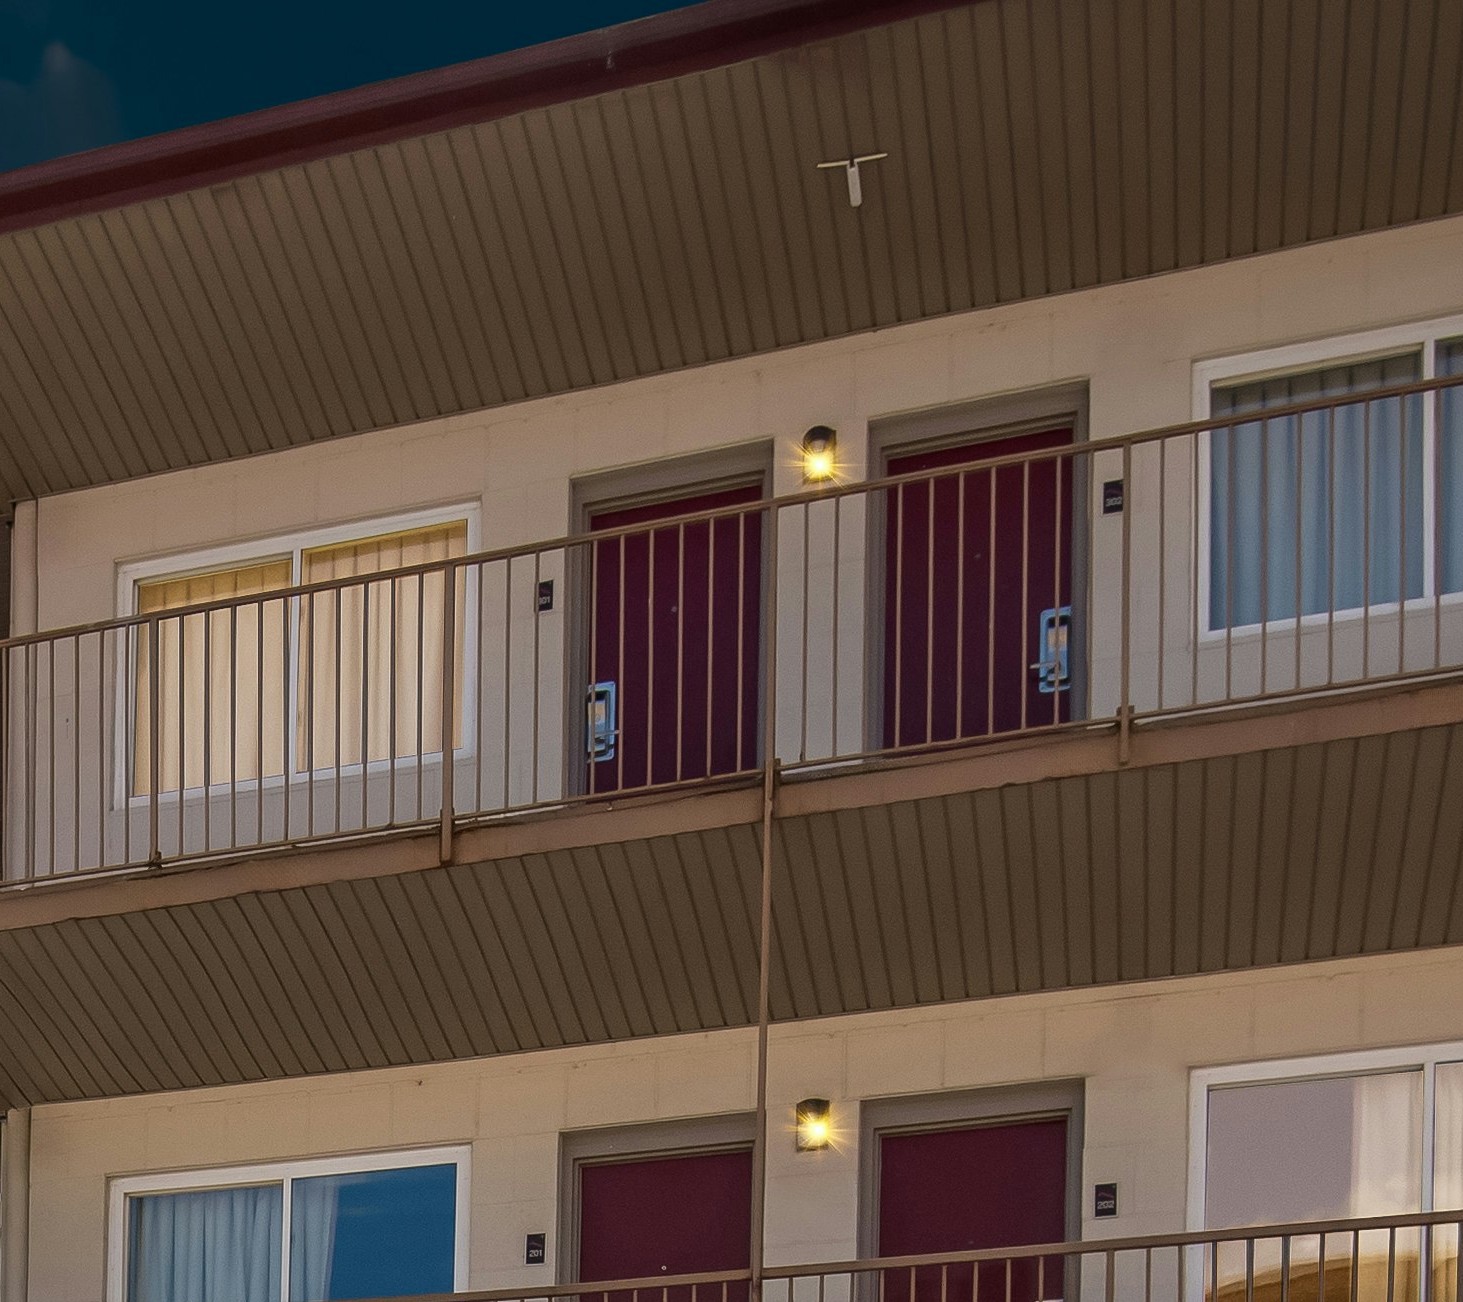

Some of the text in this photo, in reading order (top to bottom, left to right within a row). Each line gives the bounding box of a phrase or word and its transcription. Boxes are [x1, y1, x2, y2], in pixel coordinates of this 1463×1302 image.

[1105, 496, 1123, 507] 302
[1097, 1200, 1114, 1210] 202
[528, 1249, 543, 1258] 201
